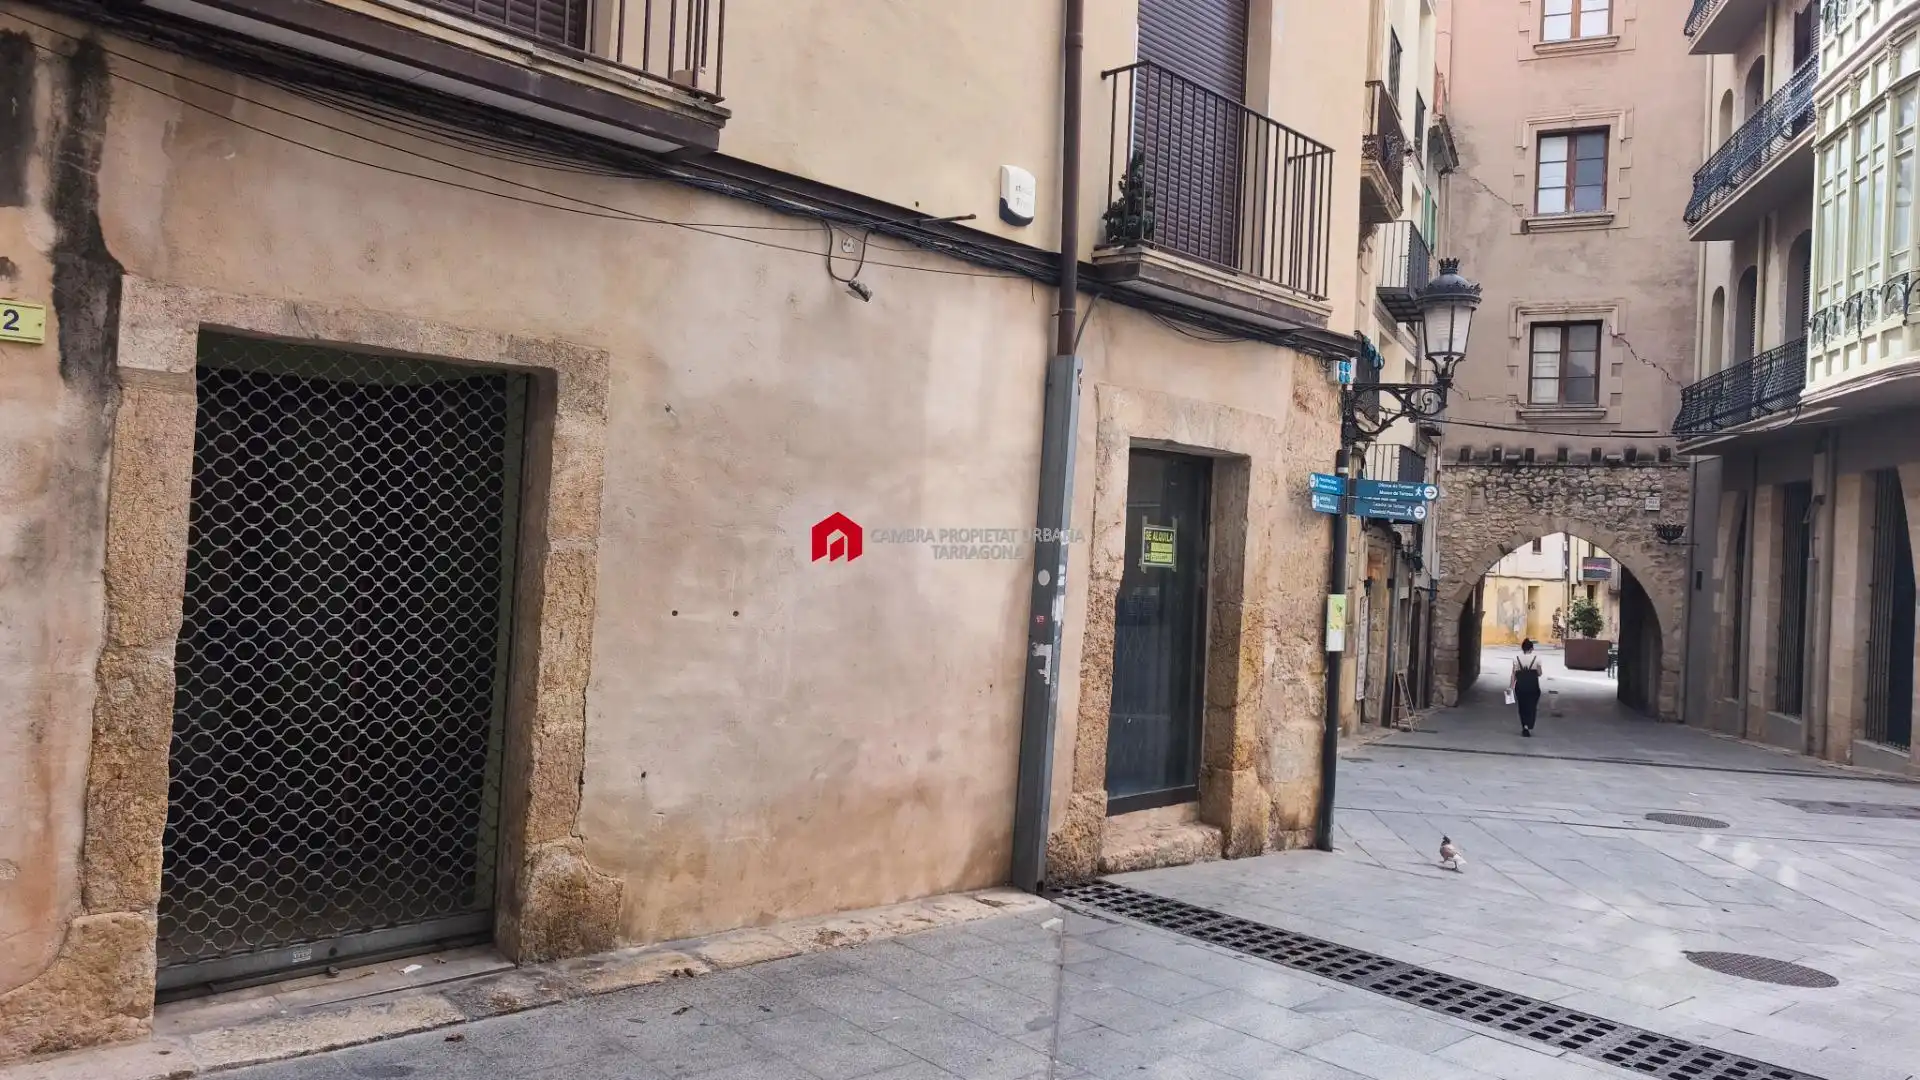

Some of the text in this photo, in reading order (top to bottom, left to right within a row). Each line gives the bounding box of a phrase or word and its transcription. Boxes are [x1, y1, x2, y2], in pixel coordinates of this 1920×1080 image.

[3, 309, 19, 331] 2
[1144, 530, 1172, 542] SE ALQUILA
